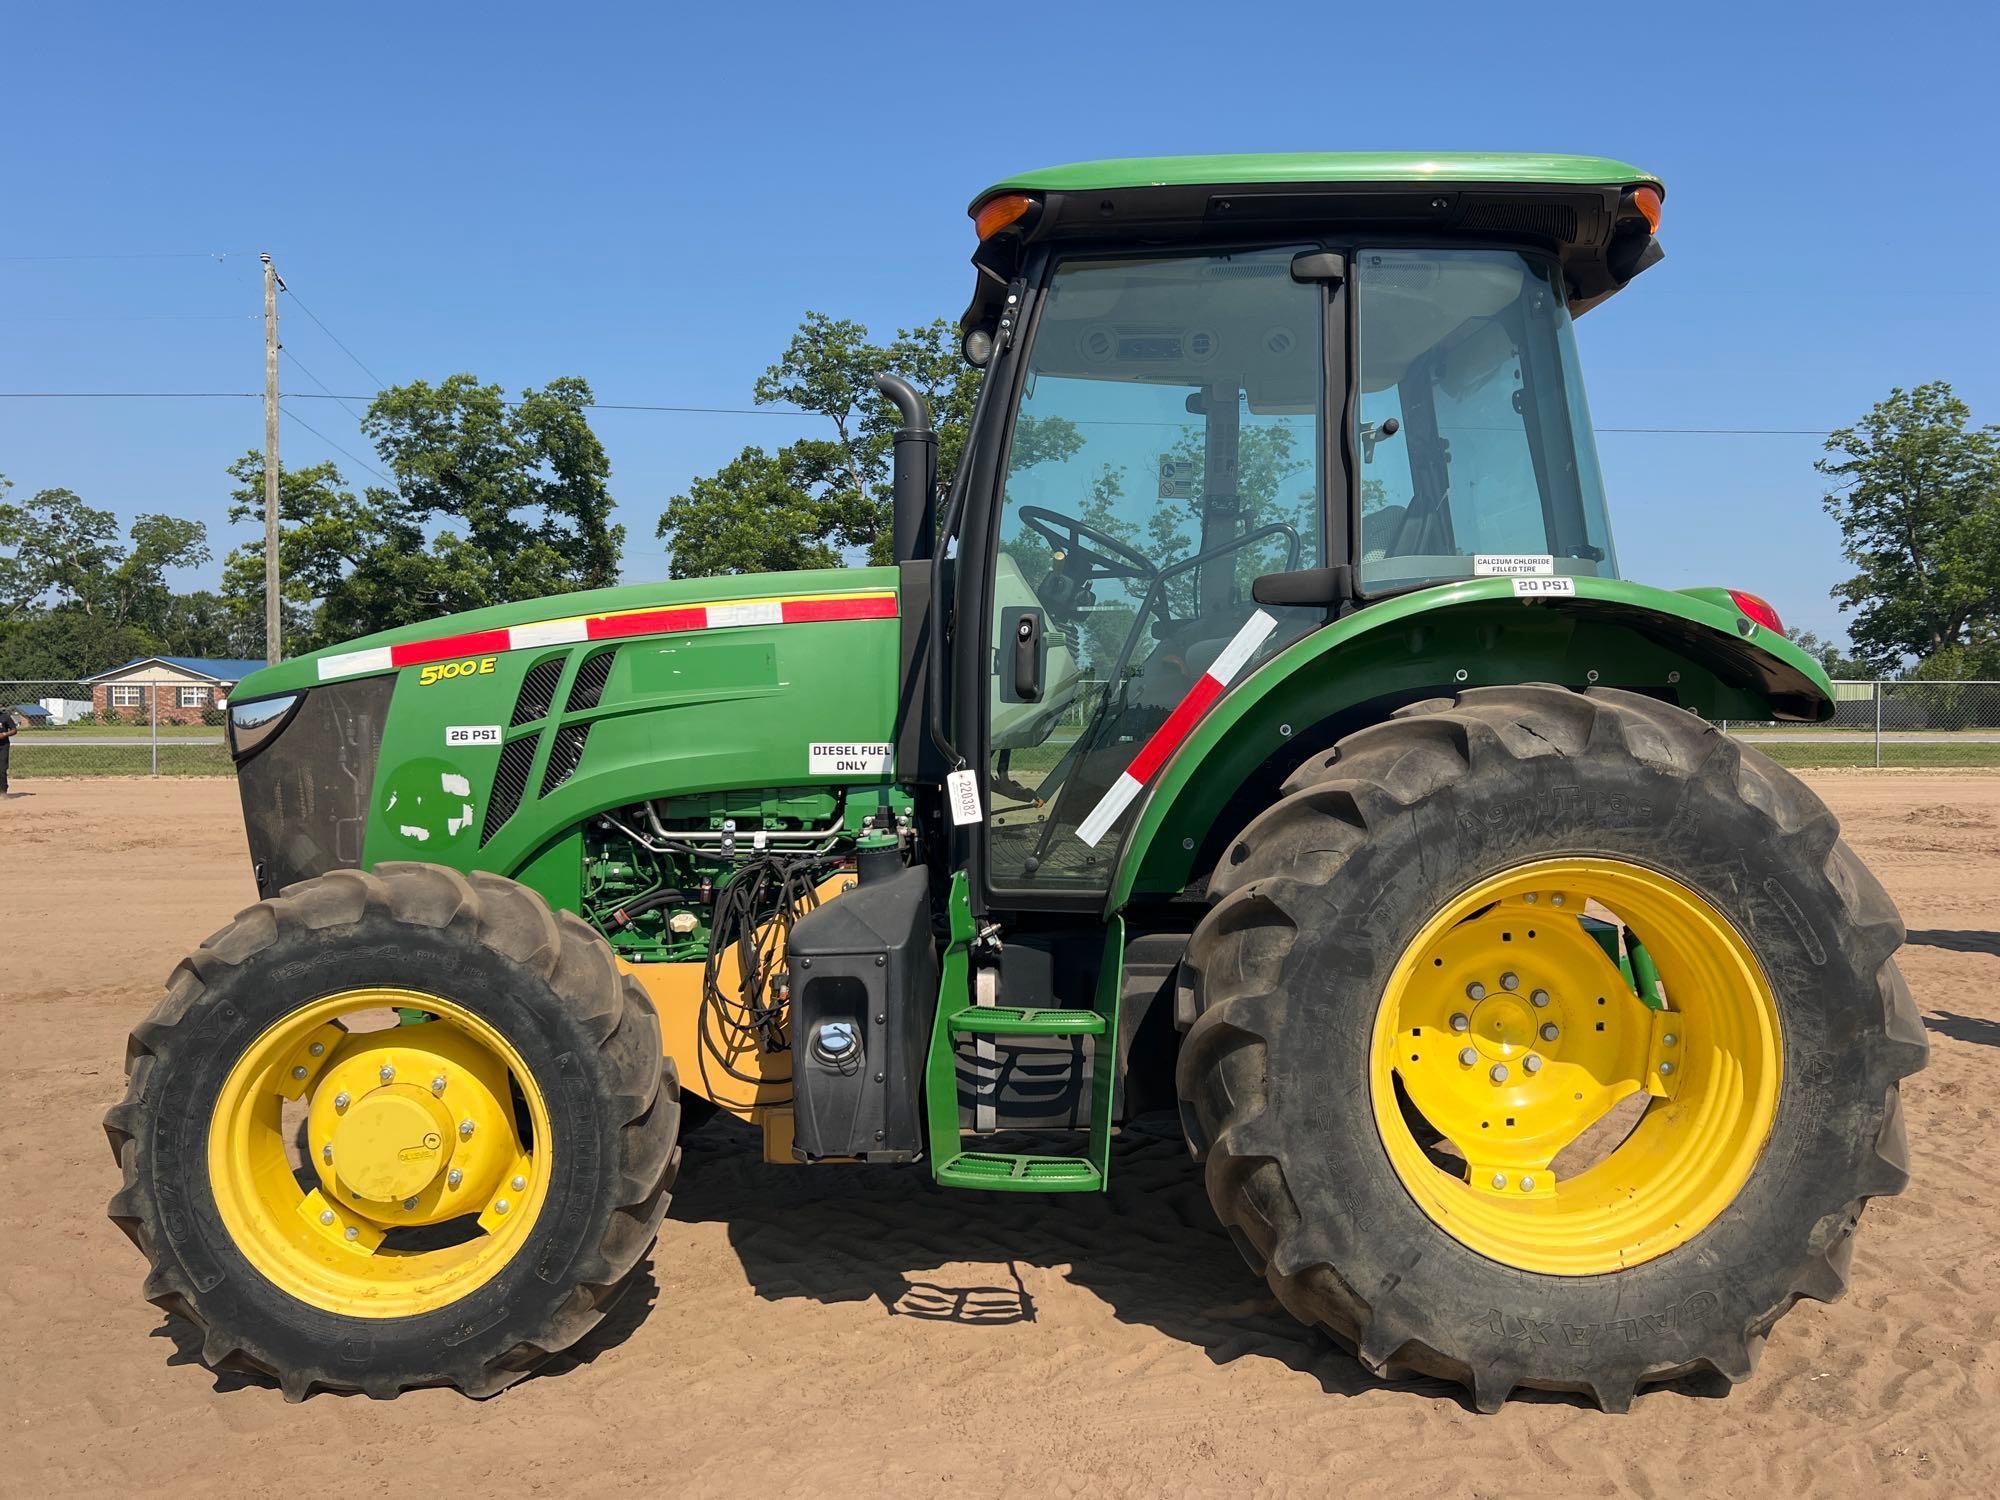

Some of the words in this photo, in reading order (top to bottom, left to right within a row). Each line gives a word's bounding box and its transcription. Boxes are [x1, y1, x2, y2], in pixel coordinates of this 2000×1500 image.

[1518, 581, 1538, 591] 20
[1543, 581, 1569, 591] PSI
[479, 656, 498, 675] E
[451, 731, 469, 741] 26
[472, 730, 497, 740] PSI
[813, 746, 858, 755] DIESEL
[861, 746, 891, 755] FUEL
[836, 761, 867, 771] ONLY
[960, 780, 977, 817] 220382
[1470, 1290, 1718, 1347] GALAXY
